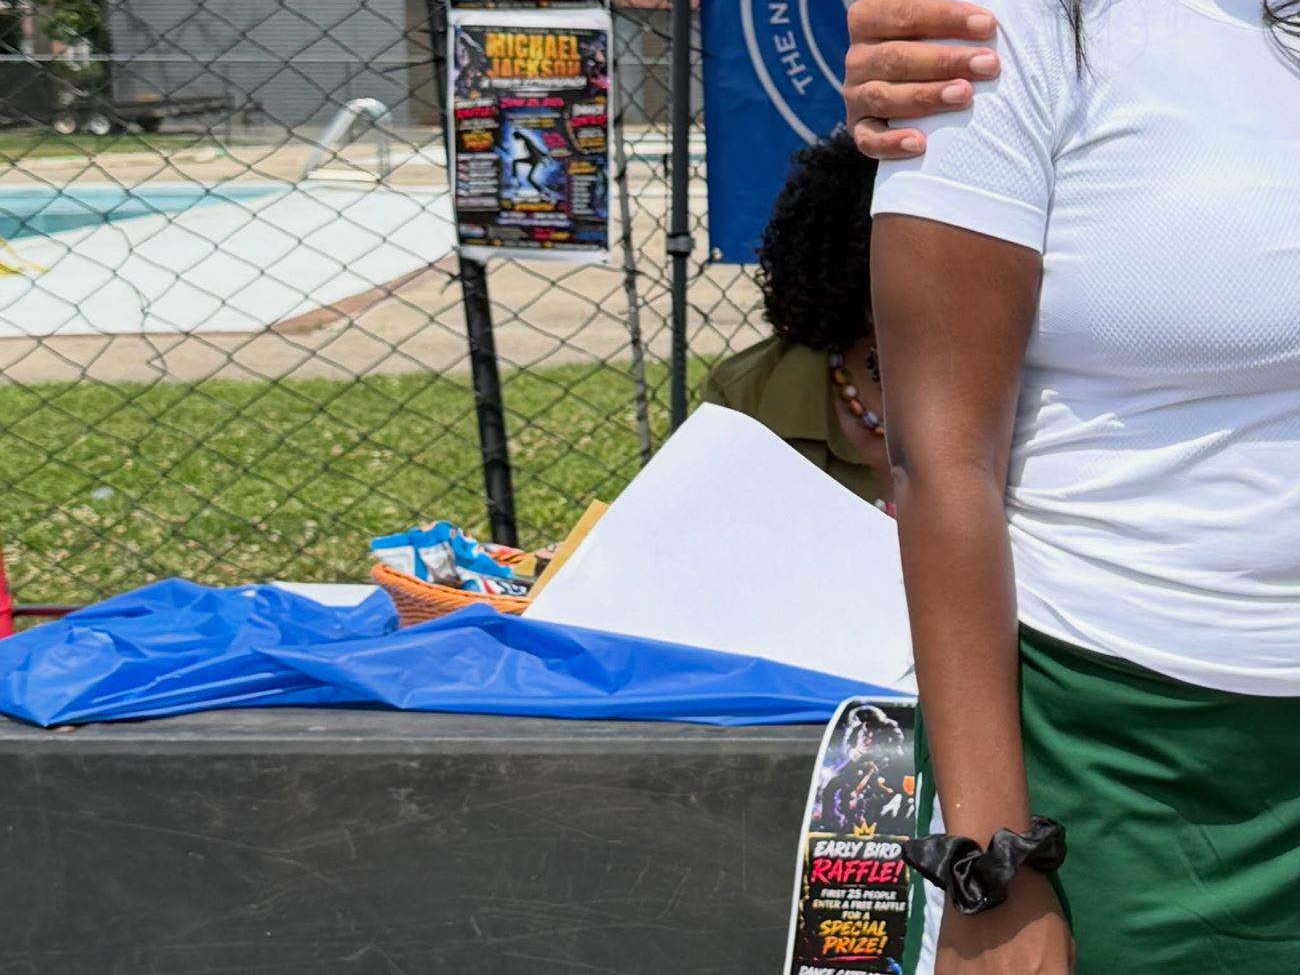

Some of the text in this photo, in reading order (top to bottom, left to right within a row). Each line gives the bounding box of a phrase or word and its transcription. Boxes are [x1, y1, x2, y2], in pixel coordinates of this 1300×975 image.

[485, 32, 581, 59] MICHAEL
[485, 58, 582, 79] JACKSON
[773, 30, 813, 95] THE
[813, 840, 903, 859] EARLY BIRD
[810, 858, 905, 885] RAFFLE!
[820, 887, 898, 901] FIRST 25 PEOPLE
[812, 898, 906, 912] ENTER A FREE RAFFLE
[841, 910, 871, 920] FOR A
[818, 919, 887, 936] SPECIAL
[822, 935, 889, 956] PRIZE!
